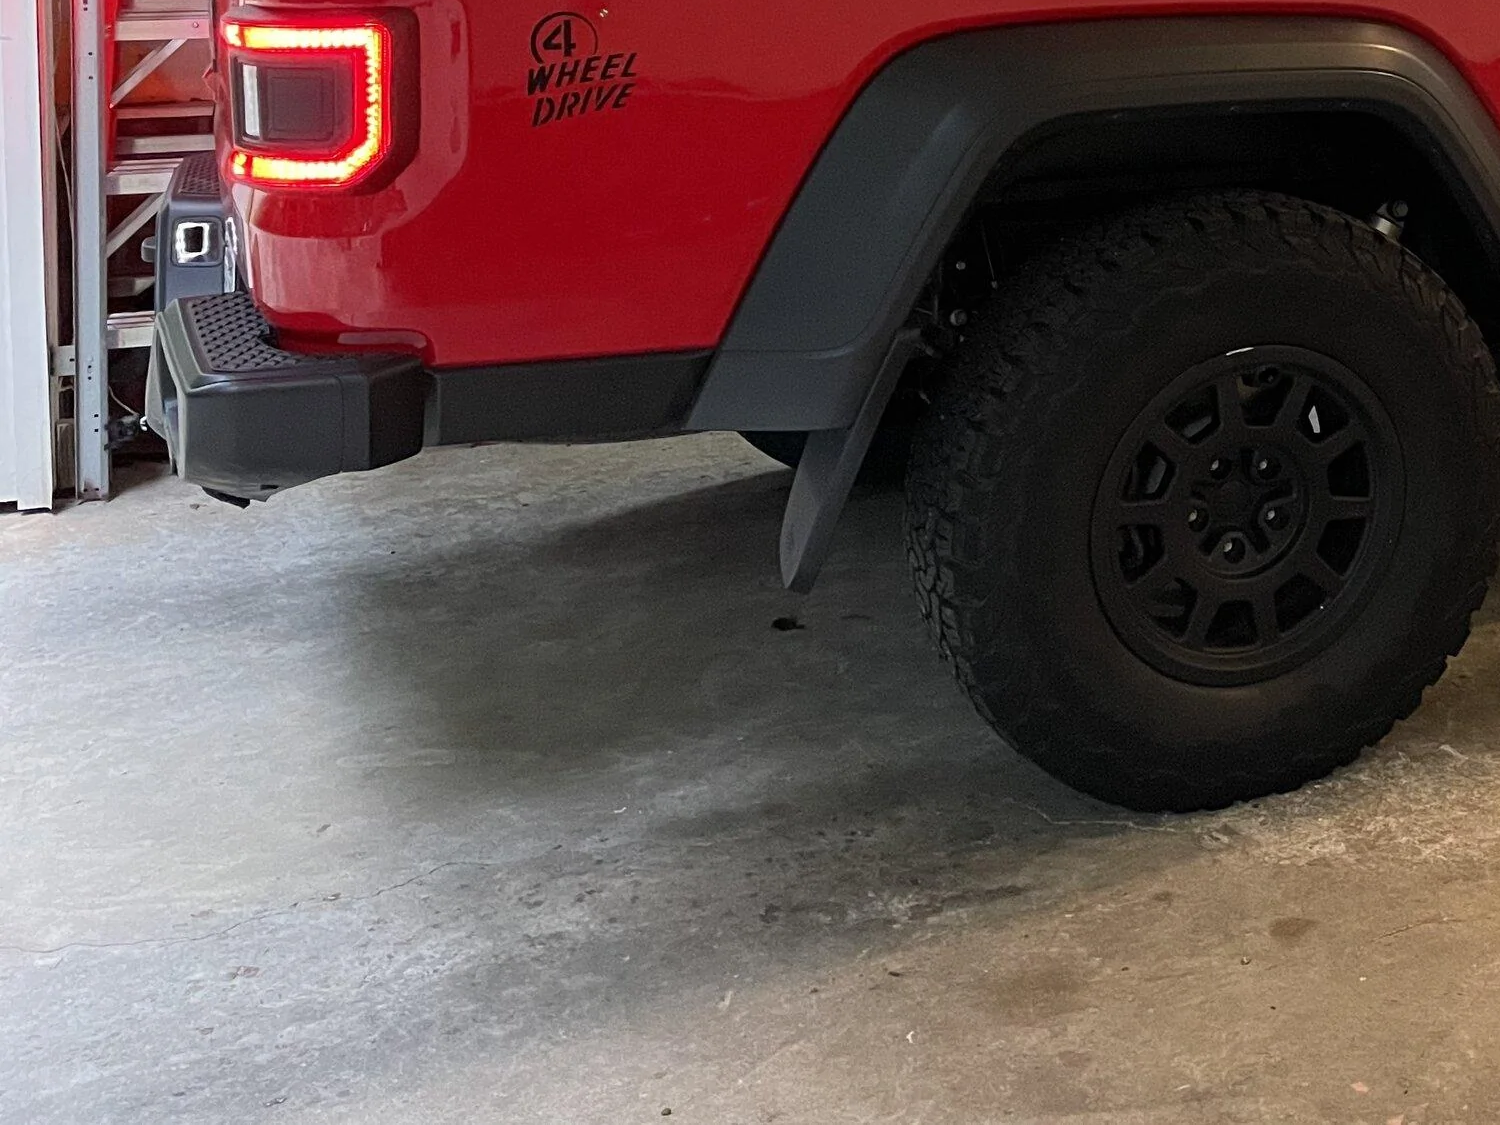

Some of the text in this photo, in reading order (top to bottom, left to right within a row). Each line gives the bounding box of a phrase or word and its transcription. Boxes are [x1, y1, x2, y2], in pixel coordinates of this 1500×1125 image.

[542, 19, 577, 57] 4
[527, 52, 638, 96] WHEEL
[532, 82, 637, 128] DRIVE
